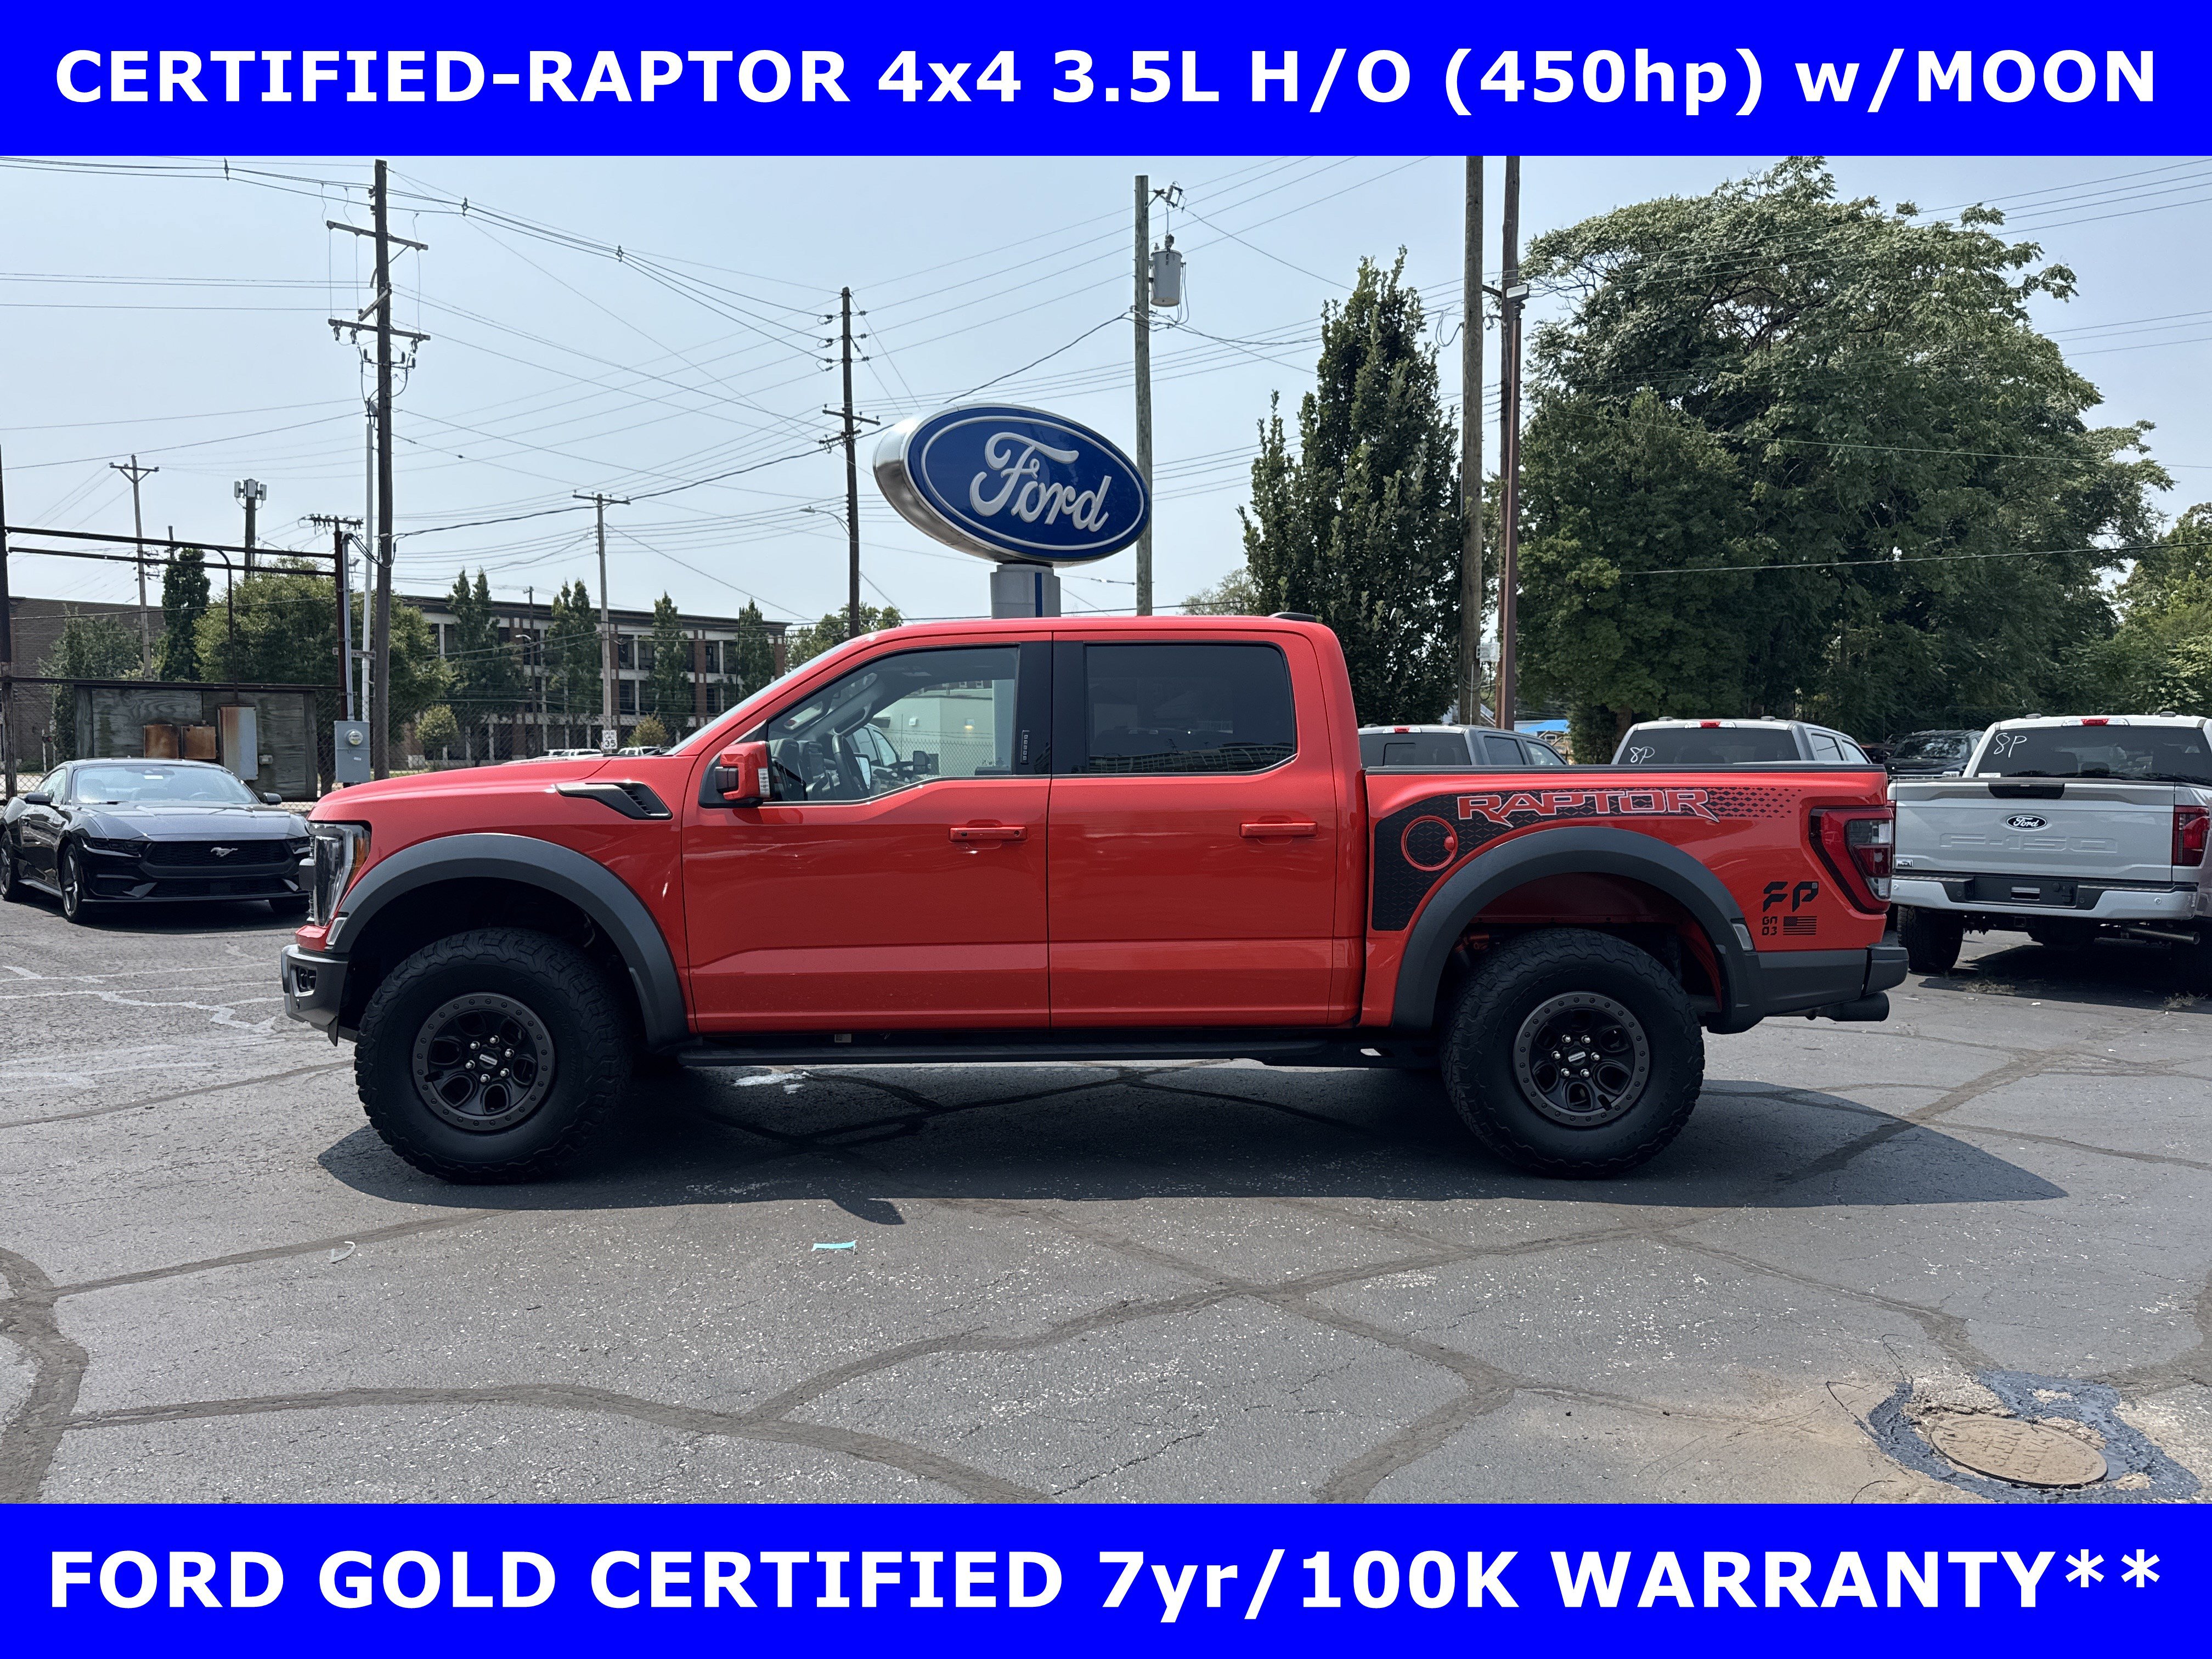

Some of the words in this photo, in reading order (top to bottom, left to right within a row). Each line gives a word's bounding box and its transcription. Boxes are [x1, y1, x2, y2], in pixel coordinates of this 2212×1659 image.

[970, 432, 1111, 532] Ford
[605, 740, 616, 748] 35
[1457, 789, 1720, 828] RAPTOR
[2013, 817, 2039, 828] Ford
[1939, 833, 2117, 853] F-150
[1763, 881, 1819, 912] FP
[1762, 927, 1777, 935] 03
